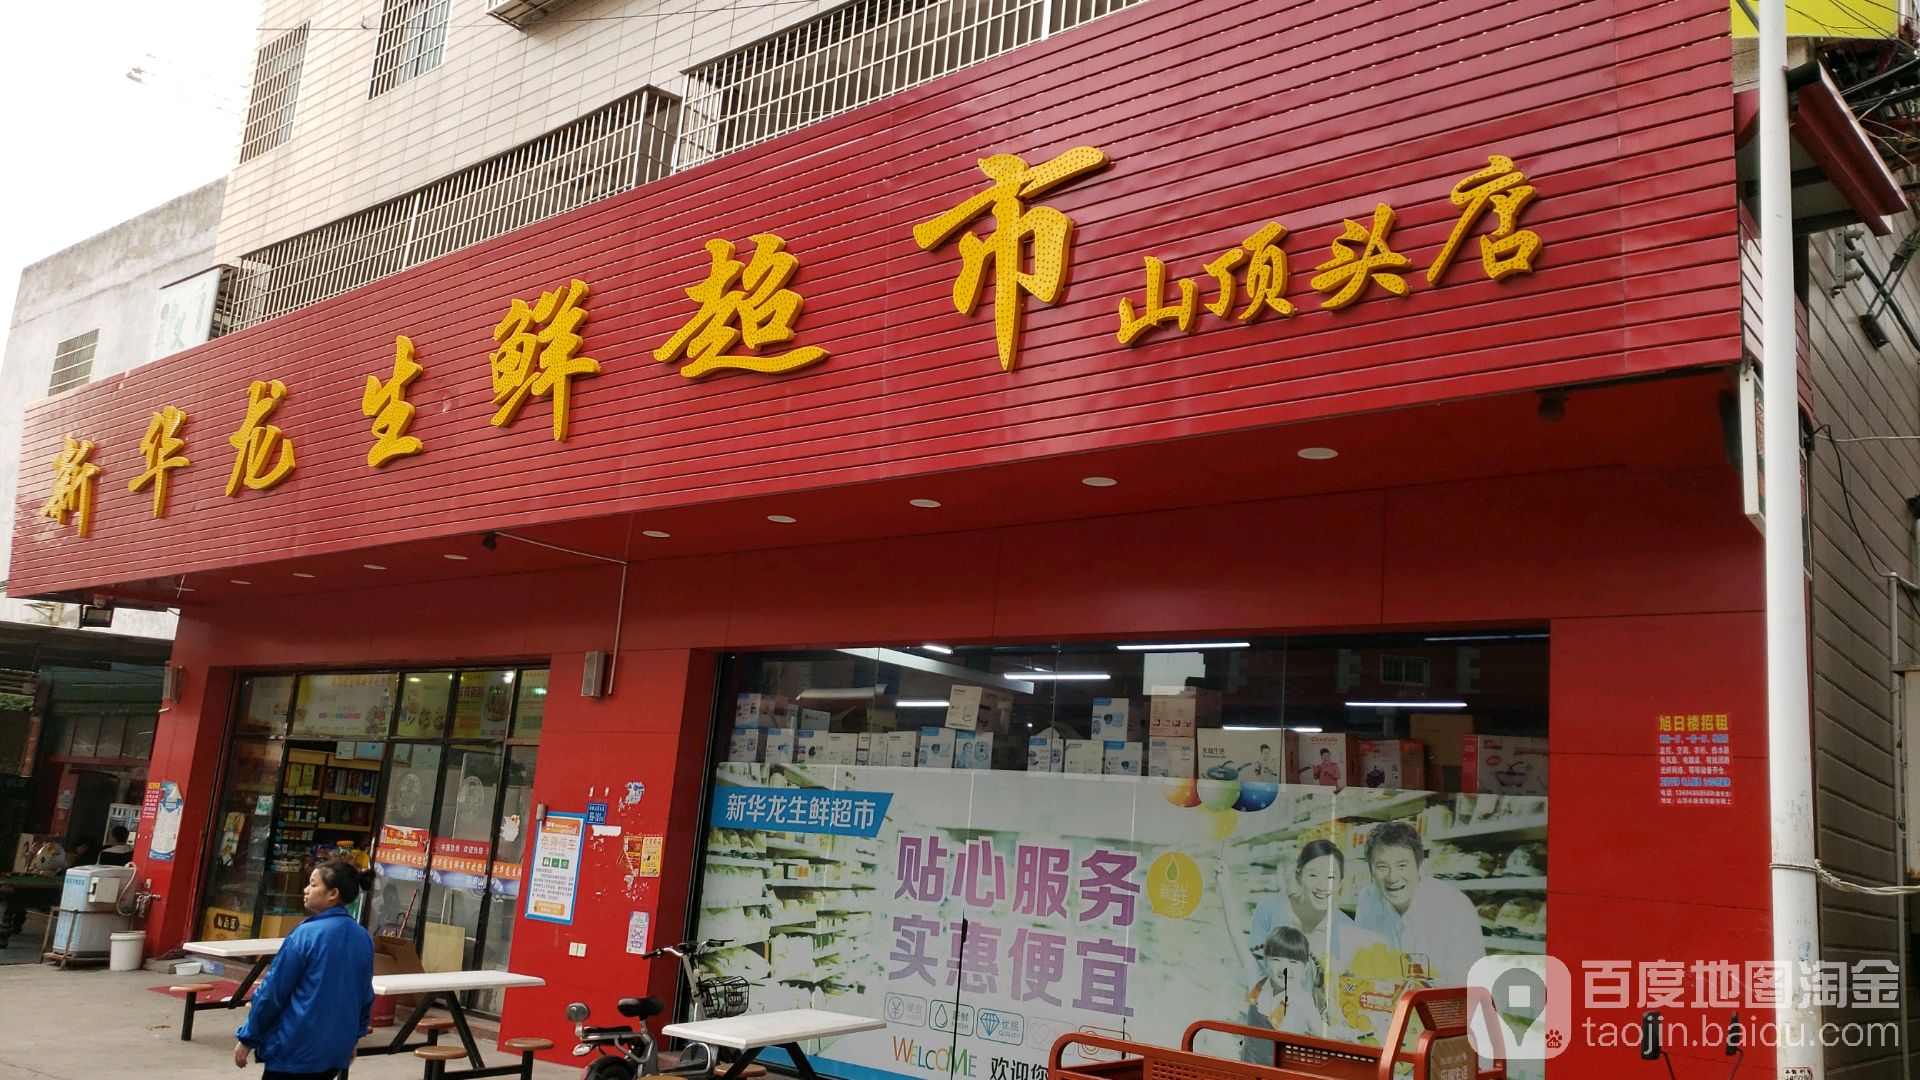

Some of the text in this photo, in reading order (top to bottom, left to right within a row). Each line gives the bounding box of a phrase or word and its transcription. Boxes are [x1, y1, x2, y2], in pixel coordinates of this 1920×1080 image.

[1117, 155, 1541, 346] 山顶头店
[42, 147, 1108, 536] 新华龙生鲜超市
[1660, 715, 1728, 731] 旭日楼招租
[726, 793, 876, 830] 新华龙生鲜超市
[894, 835, 1141, 926] 贴心服务
[889, 914, 1136, 1018] 实惠便宜
[893, 1035, 978, 1078] WELCOME
[1001, 1020, 1019, 1032] 优质
